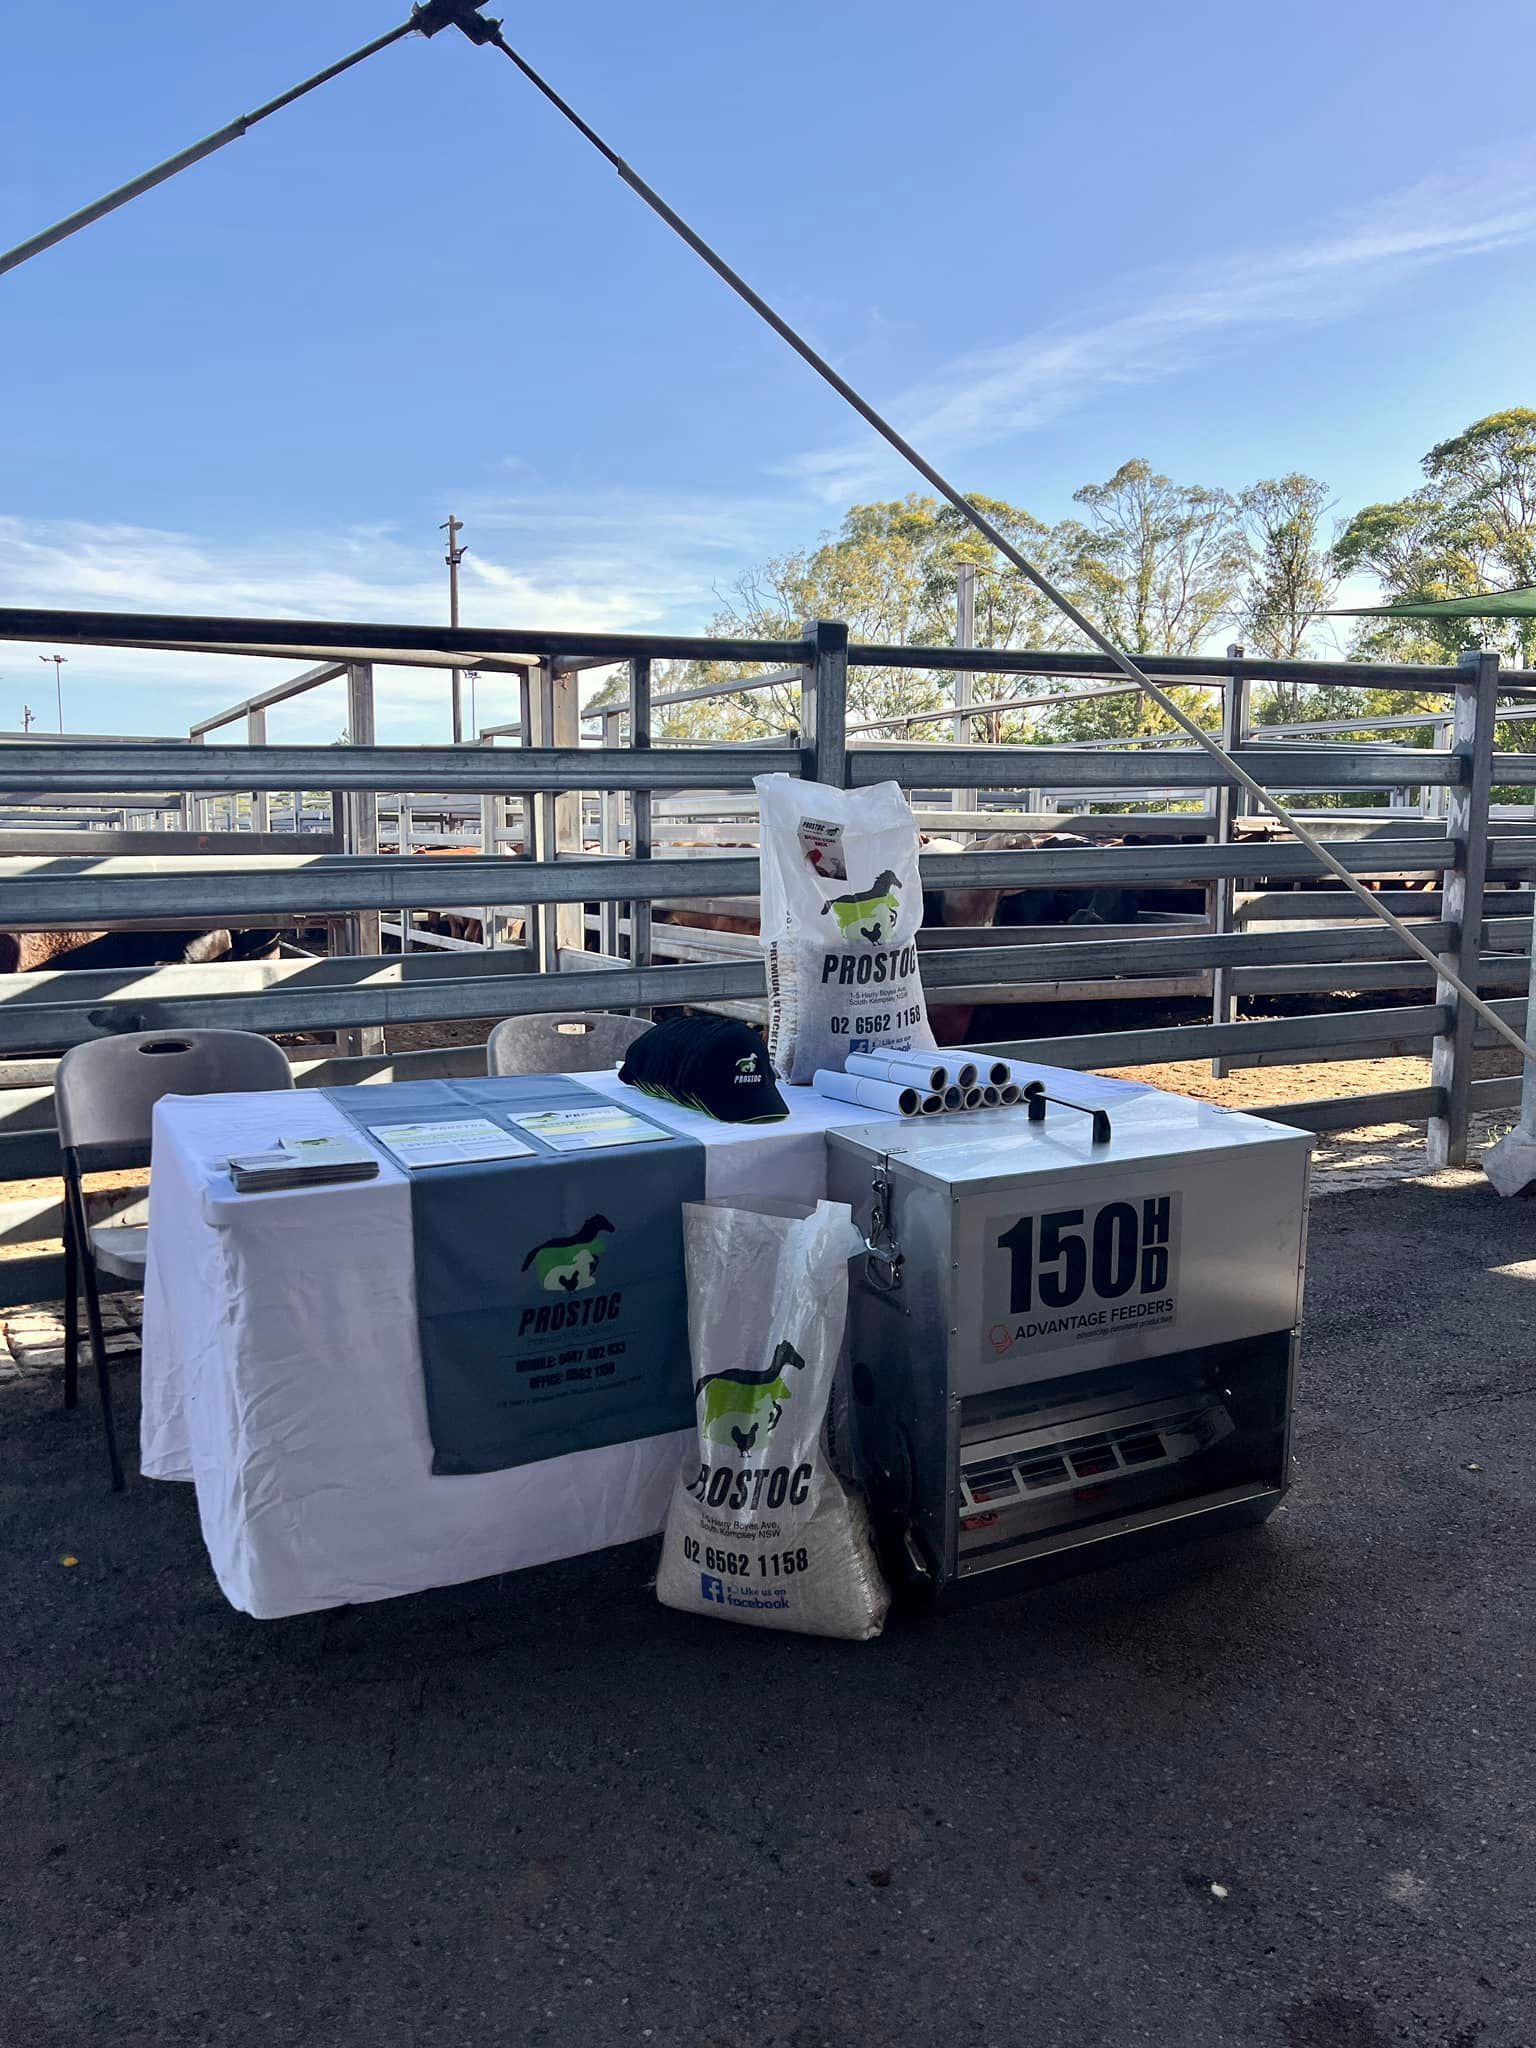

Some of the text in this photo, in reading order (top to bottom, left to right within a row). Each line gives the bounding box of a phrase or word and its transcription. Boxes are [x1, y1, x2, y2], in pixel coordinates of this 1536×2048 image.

[802, 821, 826, 832] PROSTOC
[770, 941, 781, 999] PREMIUM
[822, 944, 916, 985] PROSTOC
[862, 991, 878, 999] Harry
[831, 1004, 921, 1034] 02 6562 1158
[882, 1038, 895, 1046] Like
[734, 1074, 762, 1084] PROSTOC
[998, 1201, 1138, 1315] 150
[518, 1291, 622, 1336] PROSTOC
[1015, 1298, 1174, 1341] ADVANTAGE FEEDERS
[686, 1463, 813, 1511] ROSTOC
[711, 1518, 732, 1530] Harry
[733, 1520, 759, 1530] Boyes
[719, 1528, 757, 1541] Kempsey
[758, 1529, 781, 1538] NSW
[684, 1536, 809, 1577] 02 6562 1158
[740, 1586, 759, 1596] Like
[761, 1588, 773, 1596] us
[727, 1595, 791, 1610] facebook
